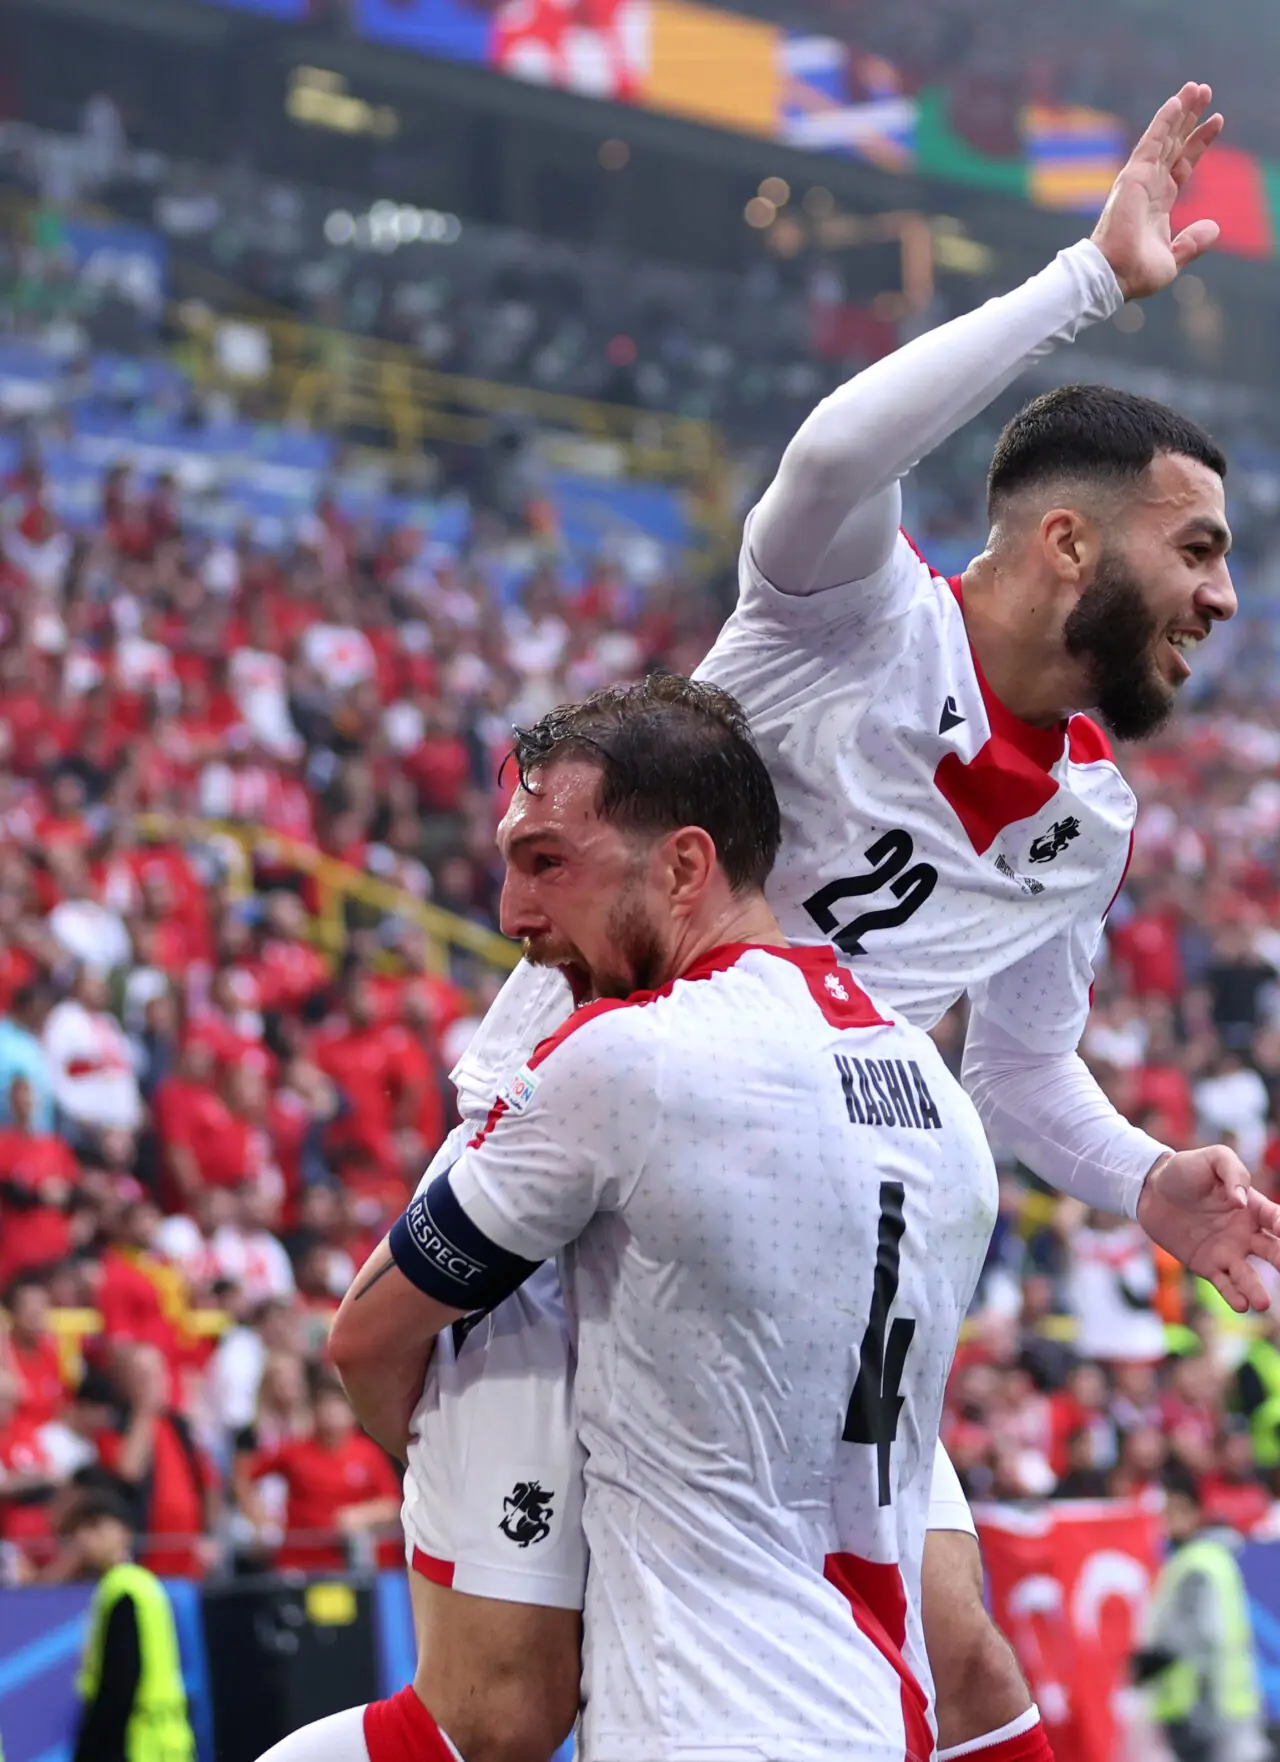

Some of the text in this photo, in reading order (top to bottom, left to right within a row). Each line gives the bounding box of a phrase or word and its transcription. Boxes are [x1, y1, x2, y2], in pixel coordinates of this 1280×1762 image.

[803, 828, 938, 956] 22
[833, 1054, 943, 1129] KASHIA
[411, 1202, 483, 1279] RESPECT
[841, 1181, 916, 1507] 4
